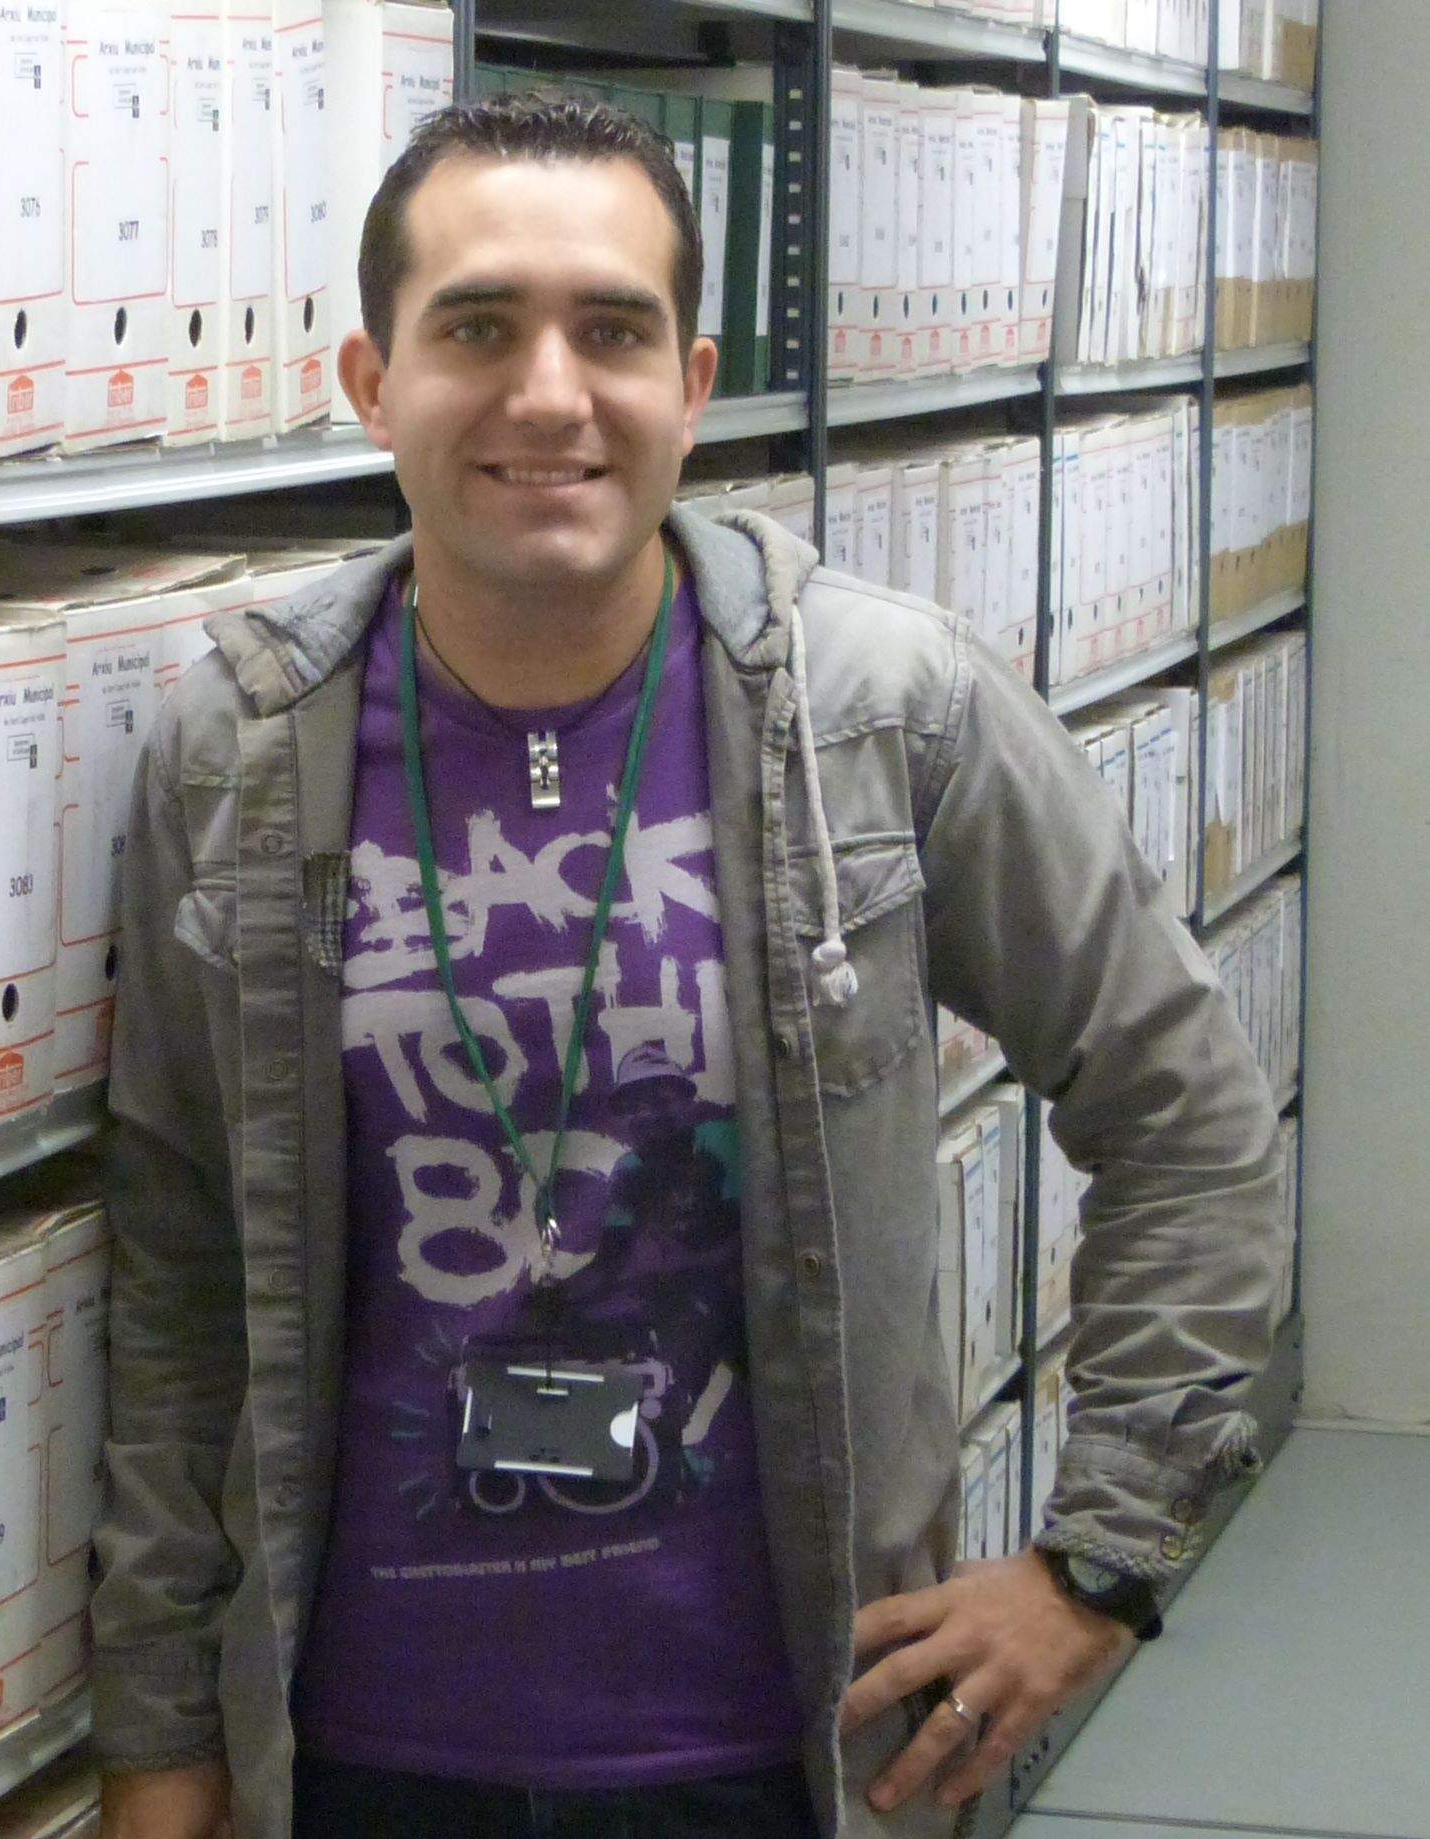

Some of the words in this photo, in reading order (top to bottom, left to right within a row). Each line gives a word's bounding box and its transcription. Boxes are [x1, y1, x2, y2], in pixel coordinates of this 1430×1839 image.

[118, 220, 139, 242] 3077
[345, 809, 722, 989] BACK
[342, 991, 528, 1123] TO
